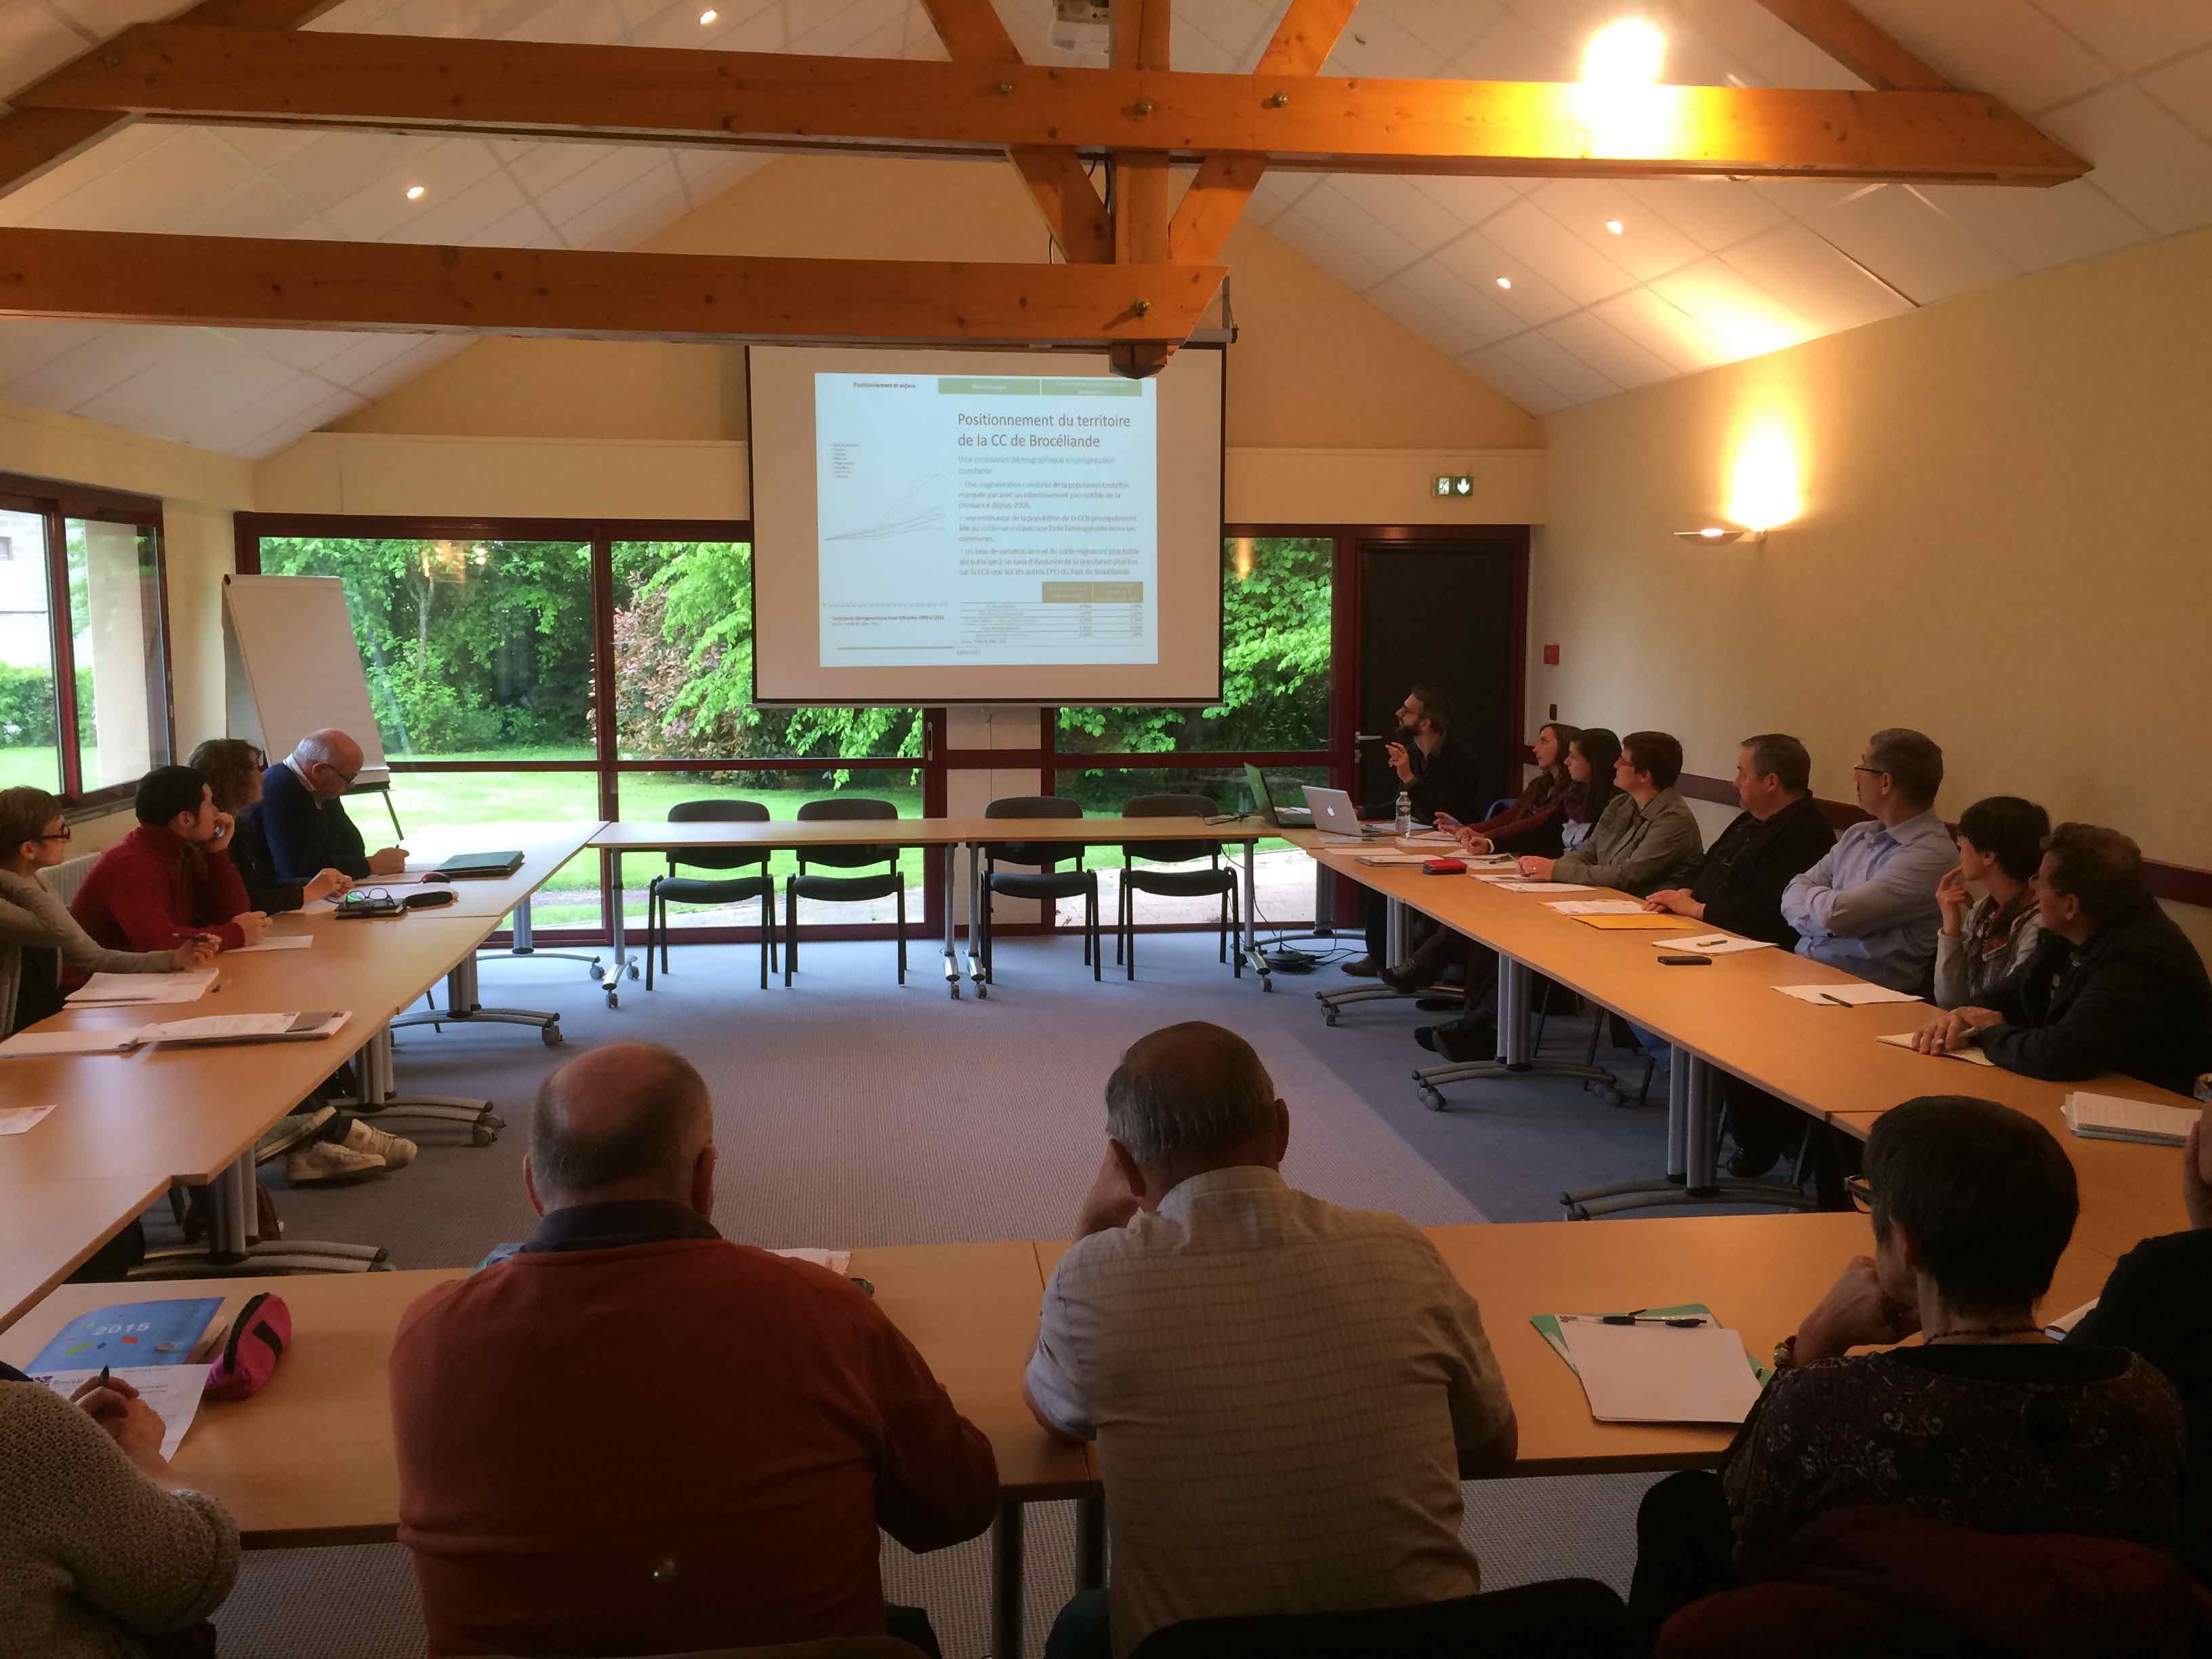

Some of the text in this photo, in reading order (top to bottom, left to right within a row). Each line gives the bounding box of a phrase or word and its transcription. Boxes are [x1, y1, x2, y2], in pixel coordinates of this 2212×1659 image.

[958, 413, 1131, 427] Positionnement du territoire
[958, 434, 1101, 447] de la CC de Brocéliande
